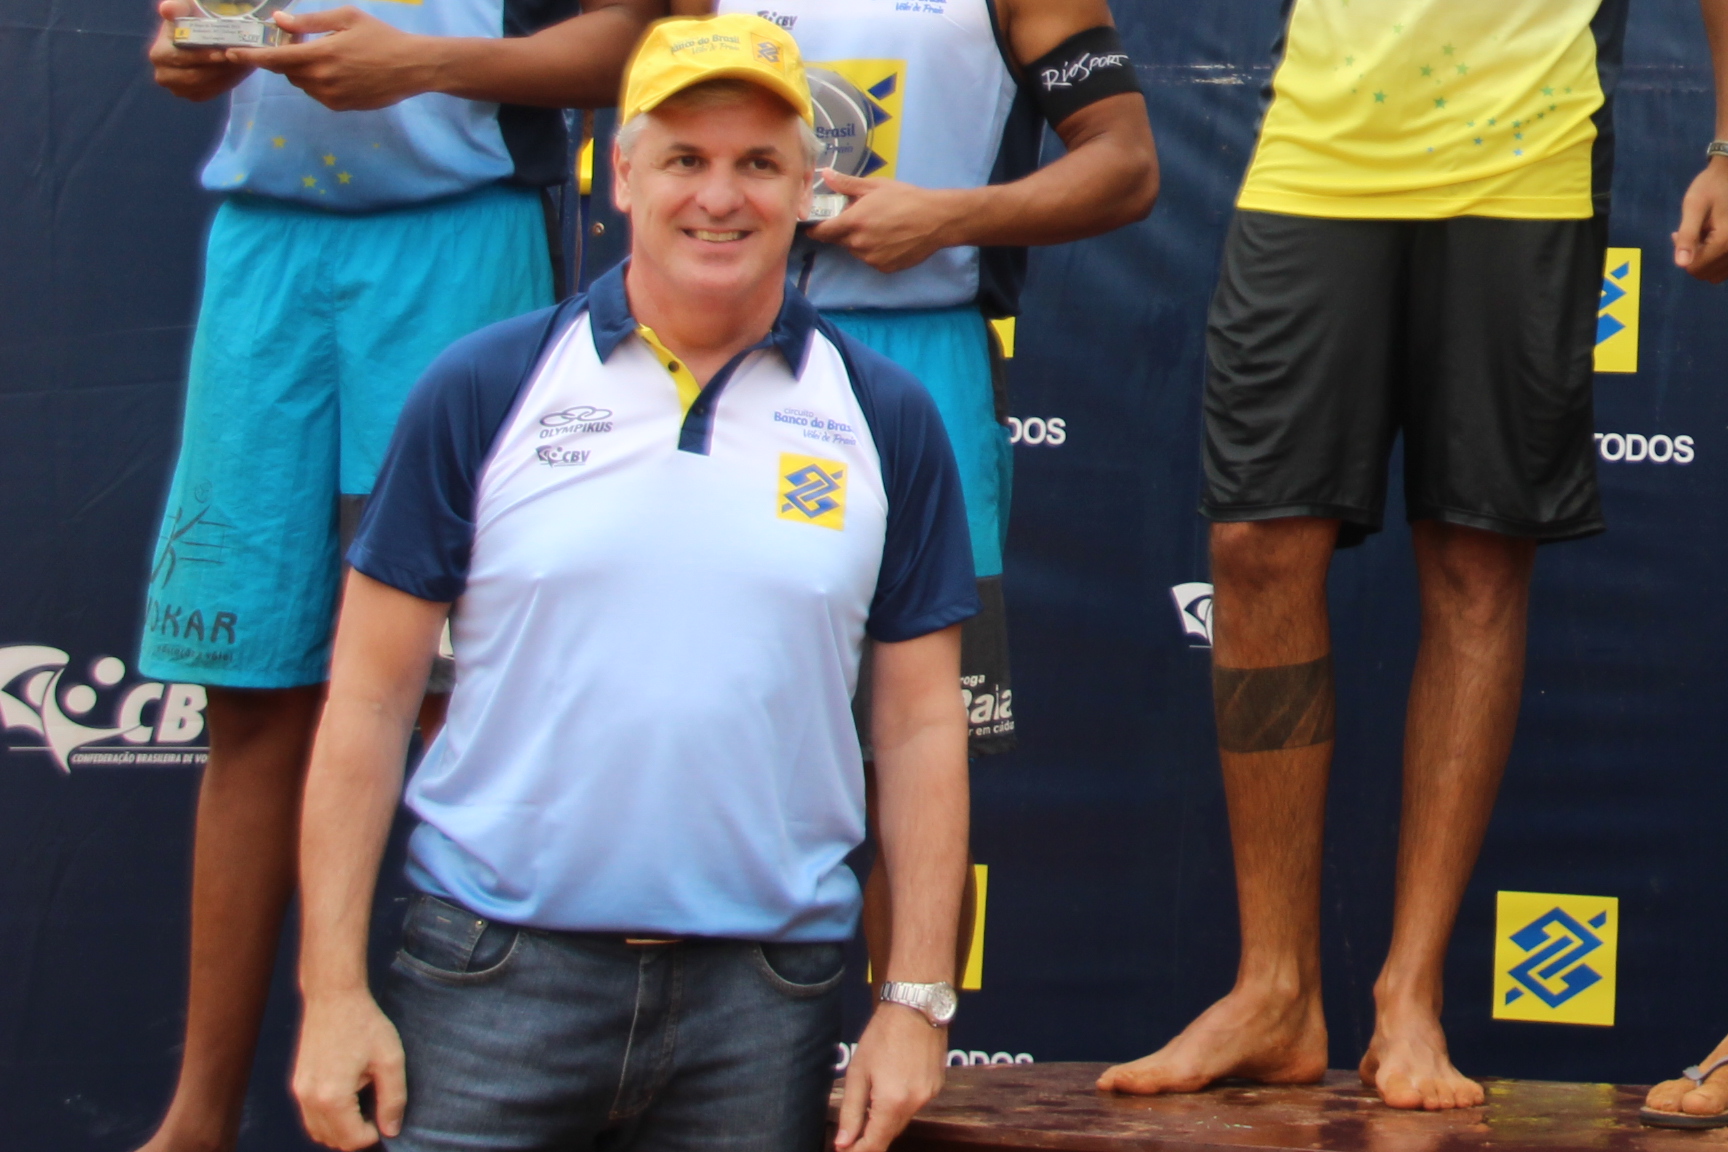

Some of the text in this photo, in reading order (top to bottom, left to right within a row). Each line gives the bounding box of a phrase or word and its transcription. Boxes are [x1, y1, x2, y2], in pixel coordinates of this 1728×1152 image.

[776, 15, 798, 28] CBV
[712, 34, 740, 44] Brasil
[815, 123, 855, 139] Brasil
[784, 407, 814, 418] circuito
[774, 411, 853, 432] Banco do Bras
[539, 421, 613, 439] OLYMPIKUS
[563, 449, 590, 463] CBV
[120, 682, 208, 743] CB
[72, 751, 135, 765] CONFEDERAÇÃO
[136, 752, 181, 764] BRASILEIRA
[183, 753, 193, 764] DE
